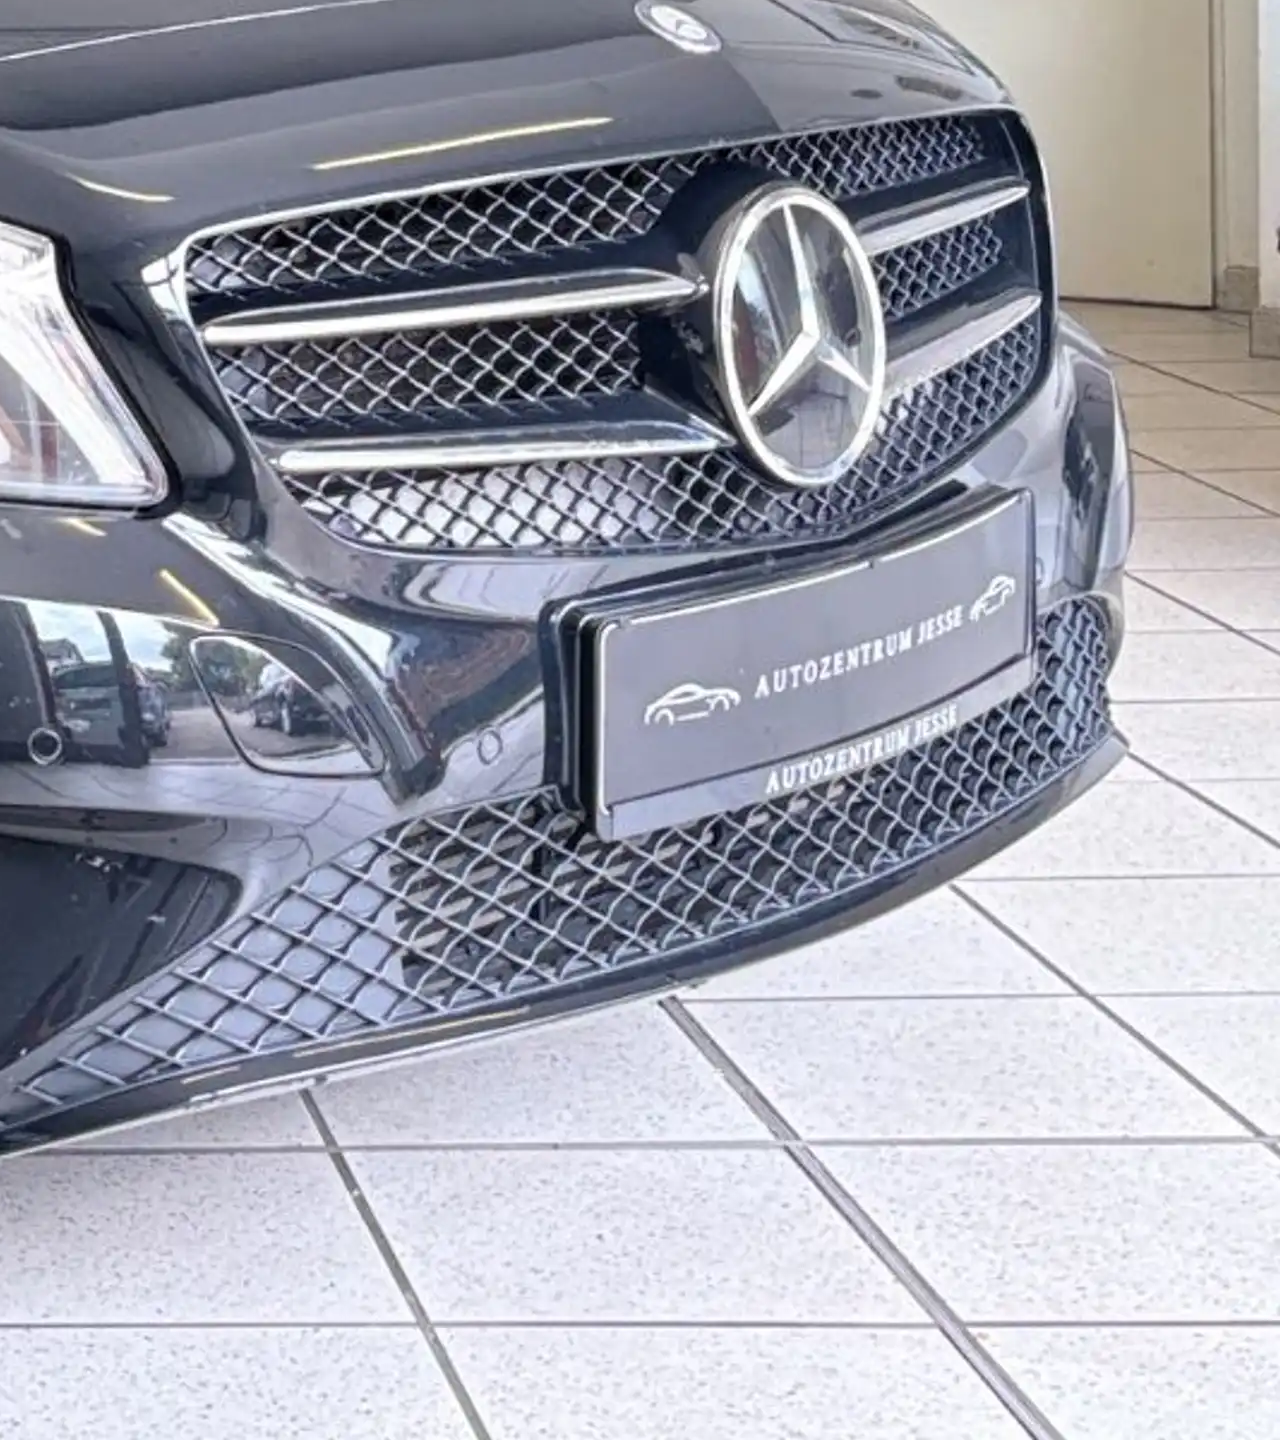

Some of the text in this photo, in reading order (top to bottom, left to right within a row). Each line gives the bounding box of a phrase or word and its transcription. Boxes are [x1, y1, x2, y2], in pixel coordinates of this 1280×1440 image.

[754, 605, 963, 700] AUTOZENTRUM JESSE
[765, 703, 958, 795] AUTOZENTRUM JESSE
